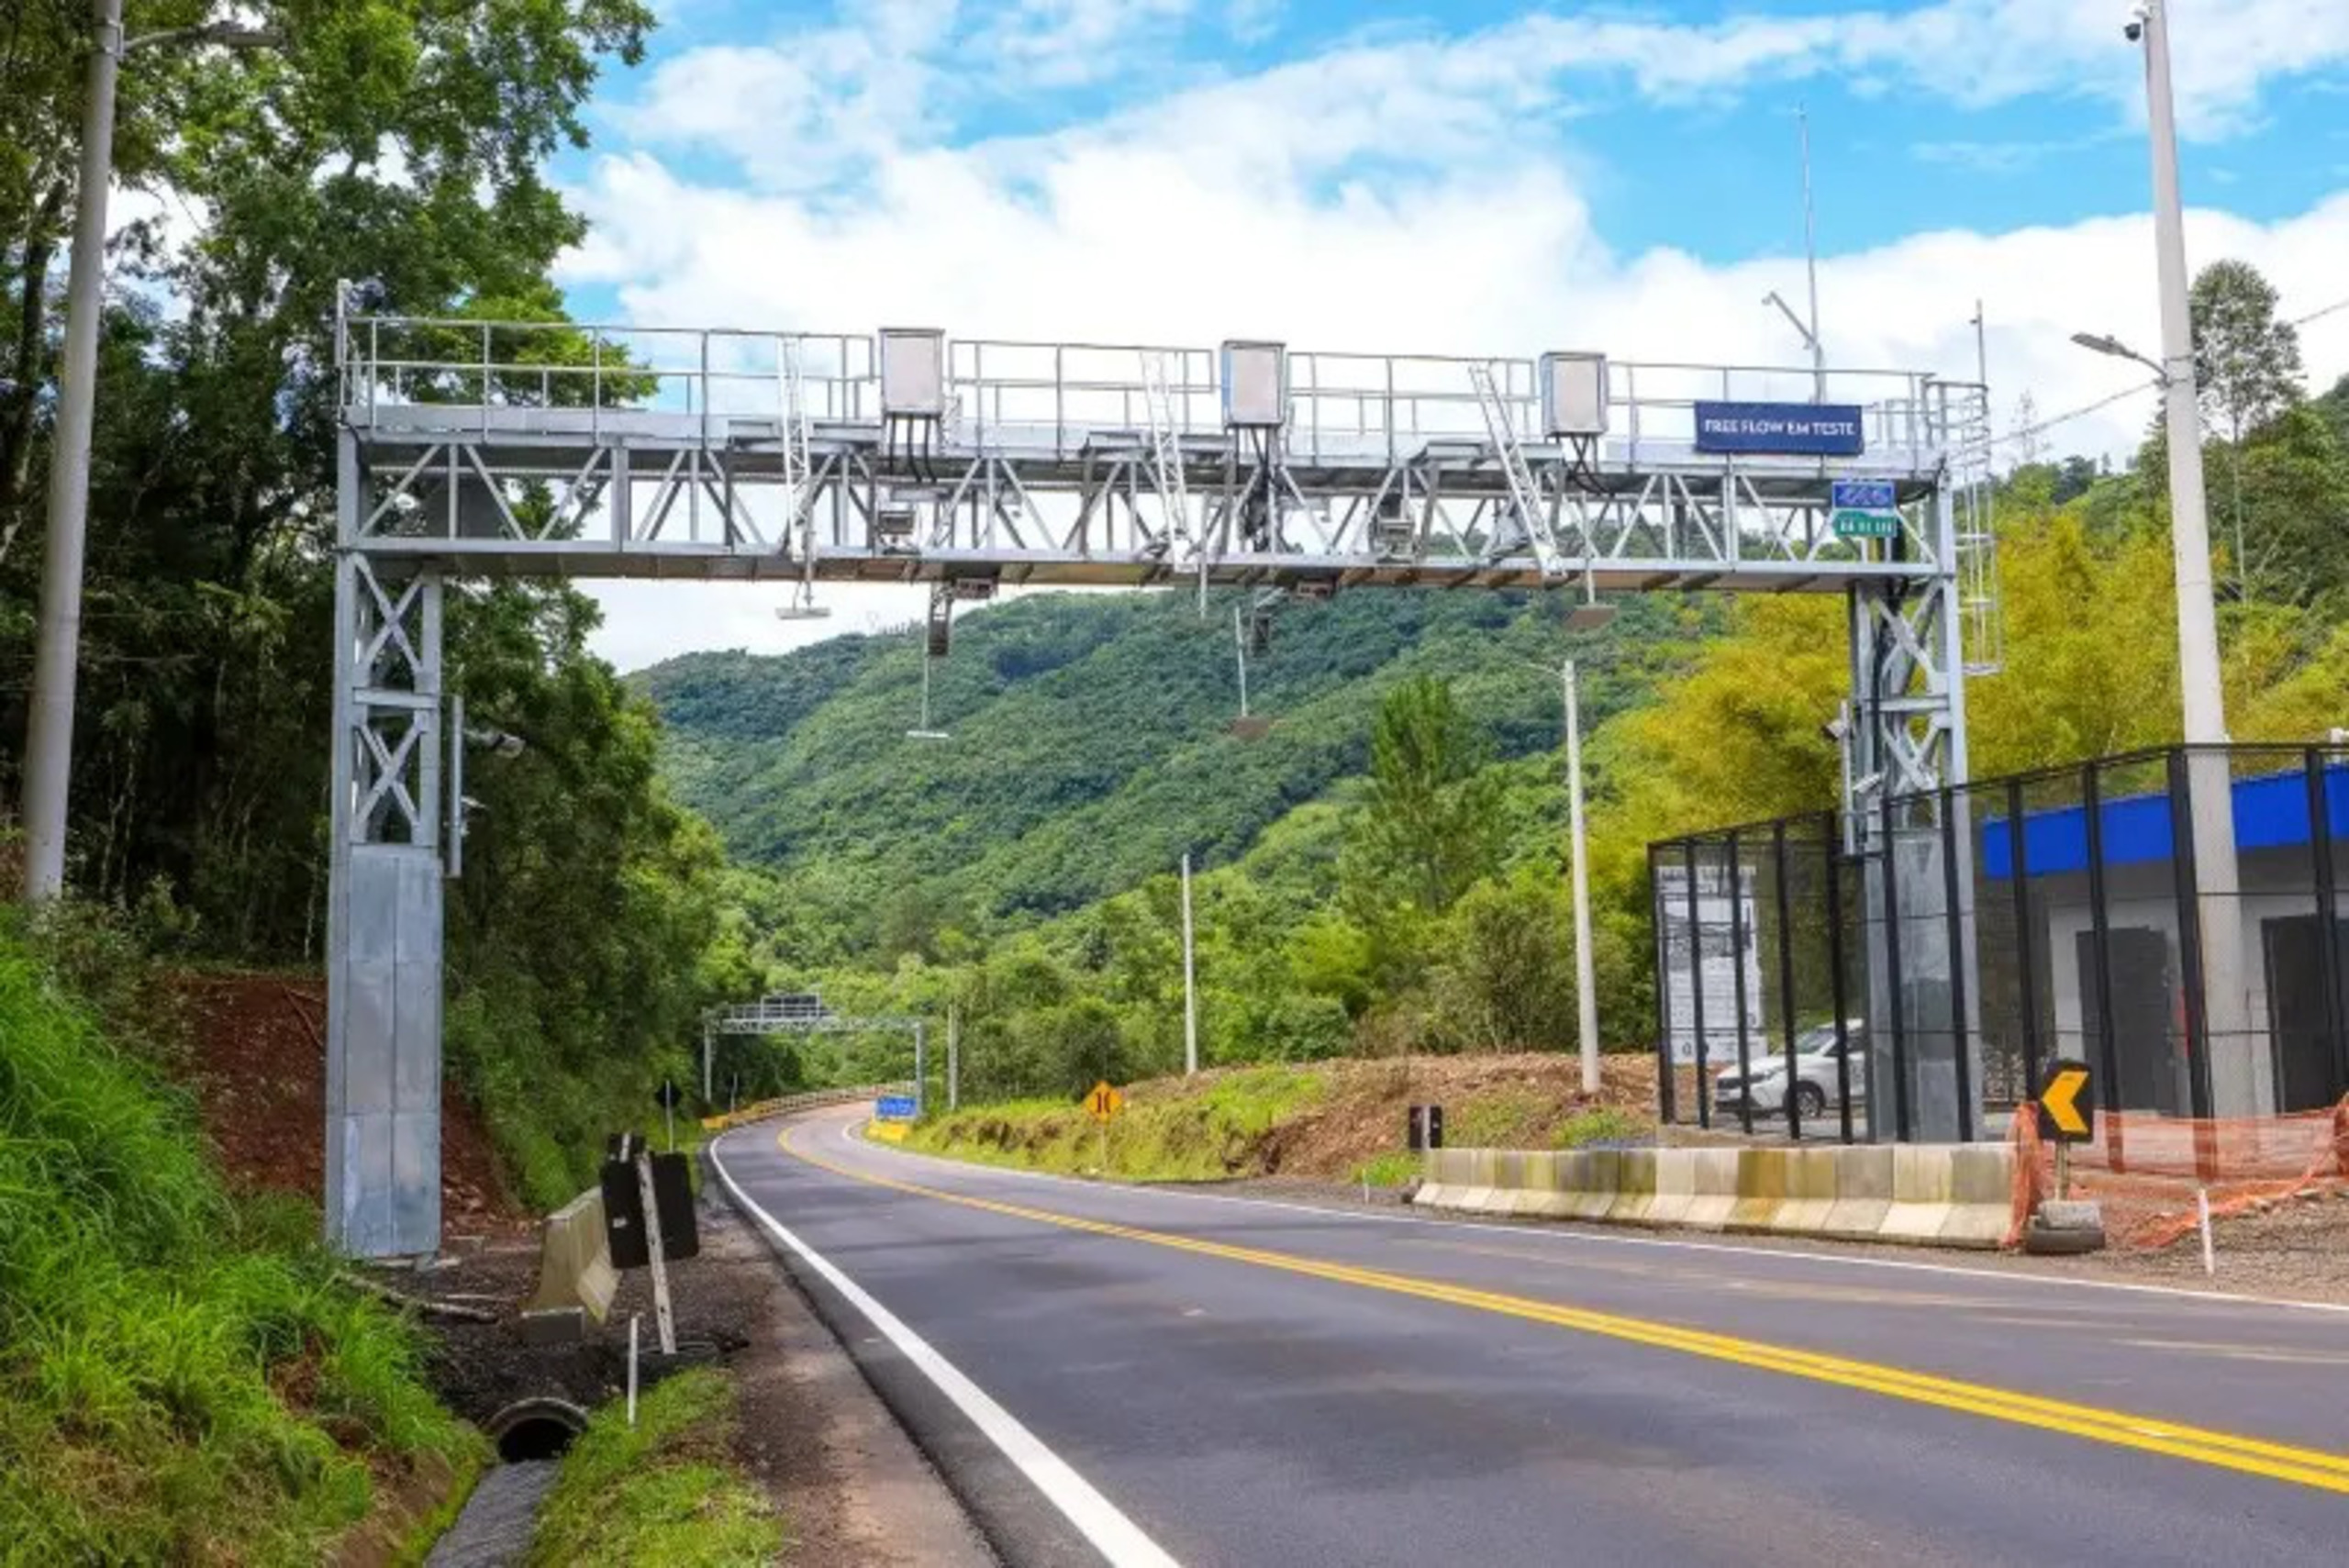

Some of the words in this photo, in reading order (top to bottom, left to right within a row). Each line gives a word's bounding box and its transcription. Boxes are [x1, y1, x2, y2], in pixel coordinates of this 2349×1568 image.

[1705, 419, 1739, 433] FREE
[1741, 420, 1783, 434] FLOW
[1787, 421, 1809, 435] EM
[1812, 422, 1854, 436] TESTE
